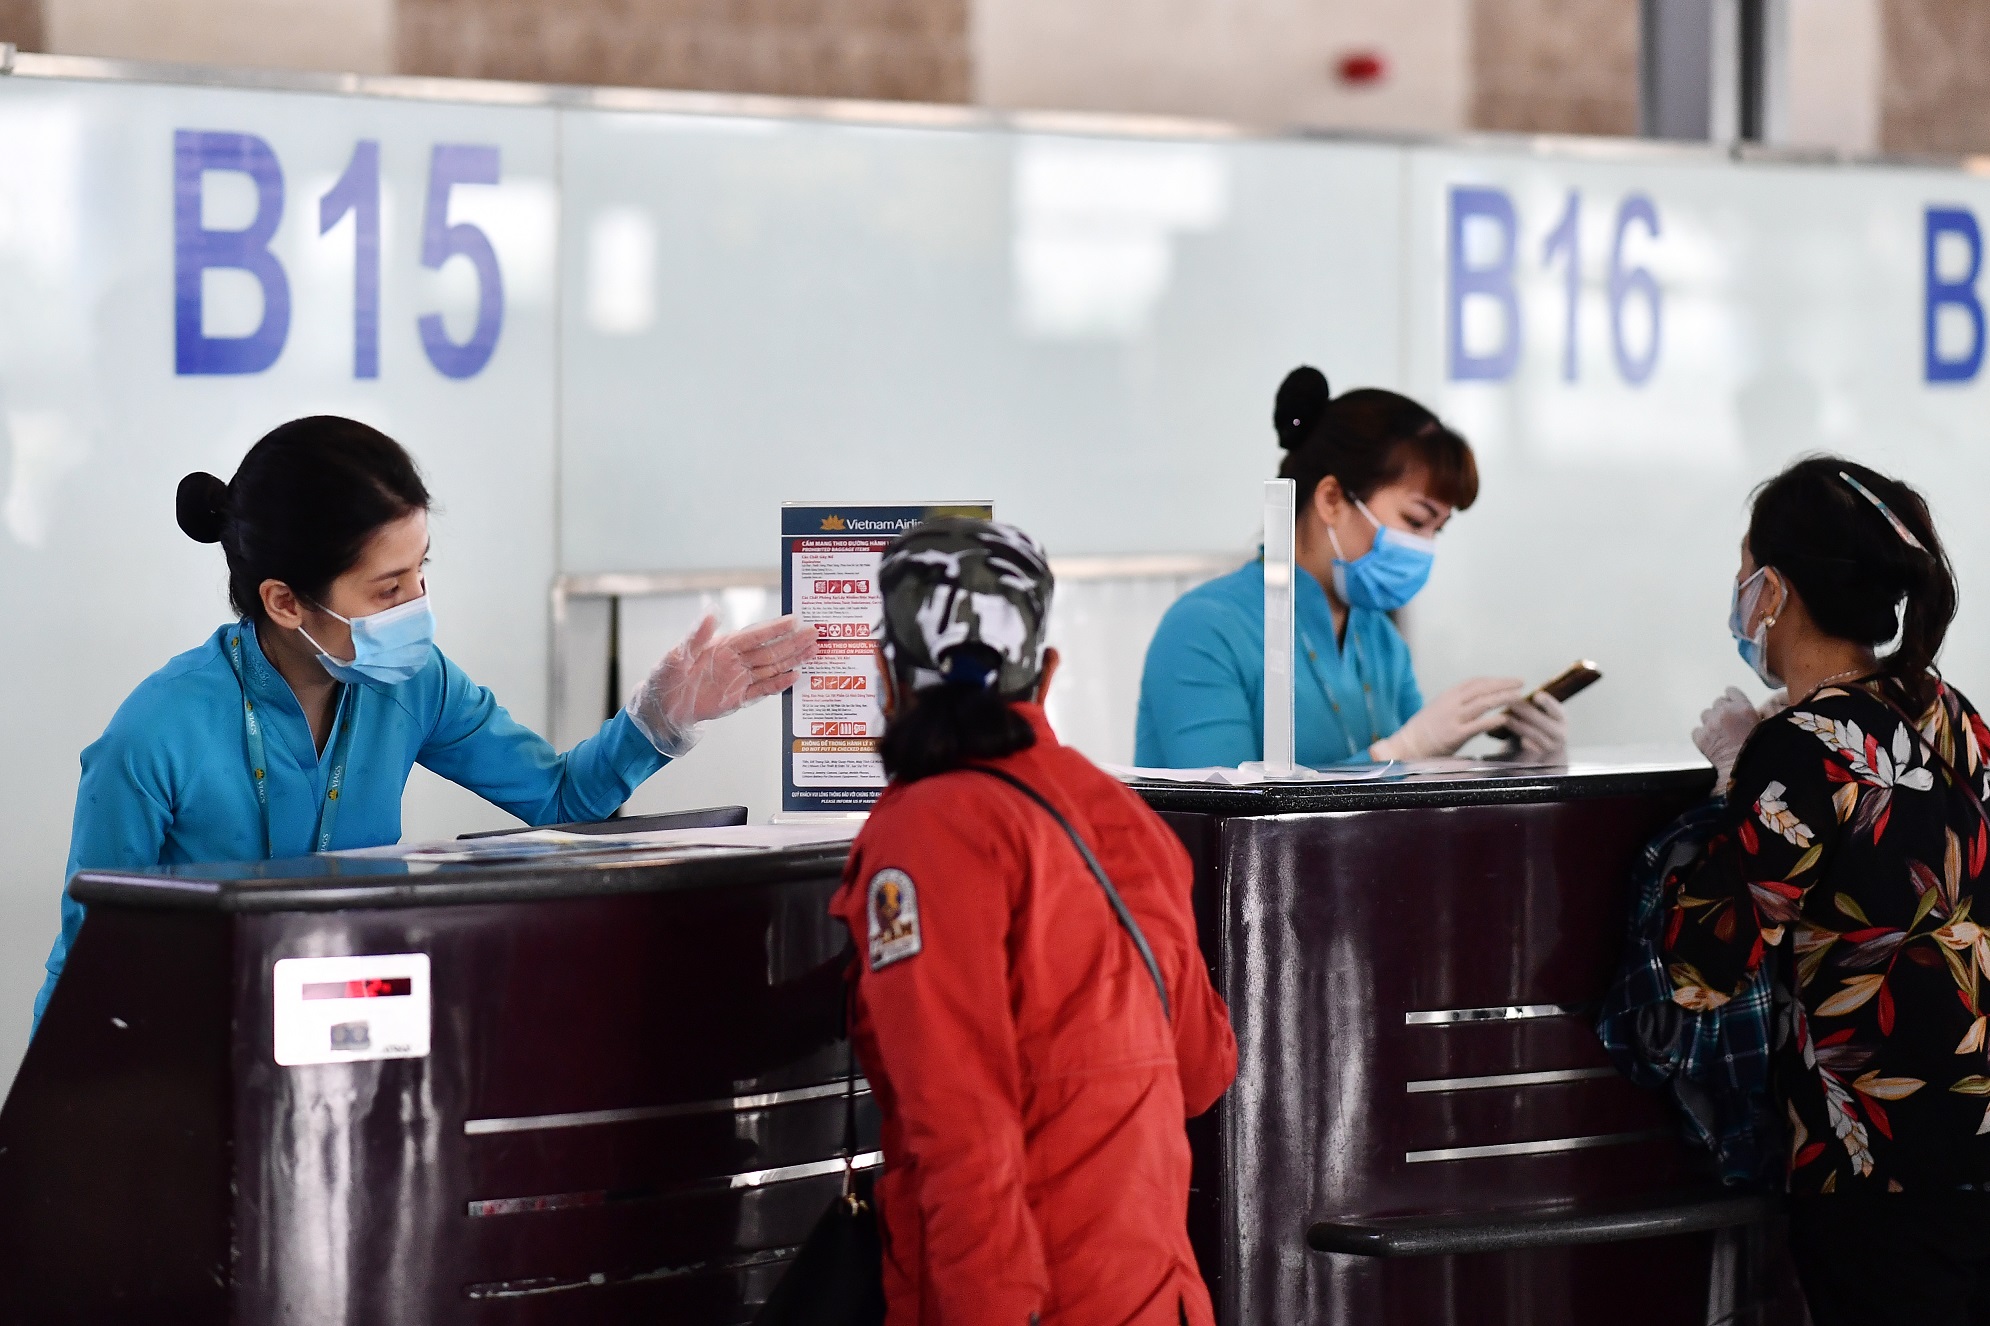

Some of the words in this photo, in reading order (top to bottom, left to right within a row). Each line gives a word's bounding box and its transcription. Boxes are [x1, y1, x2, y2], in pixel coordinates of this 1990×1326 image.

[174, 129, 504, 380] B15
[1447, 185, 1663, 384] B16
[846, 519, 895, 530] Vietnam
[894, 518, 926, 531] Airlin
[248, 711, 257, 736] VIAGS
[331, 765, 342, 788] VIAGS
